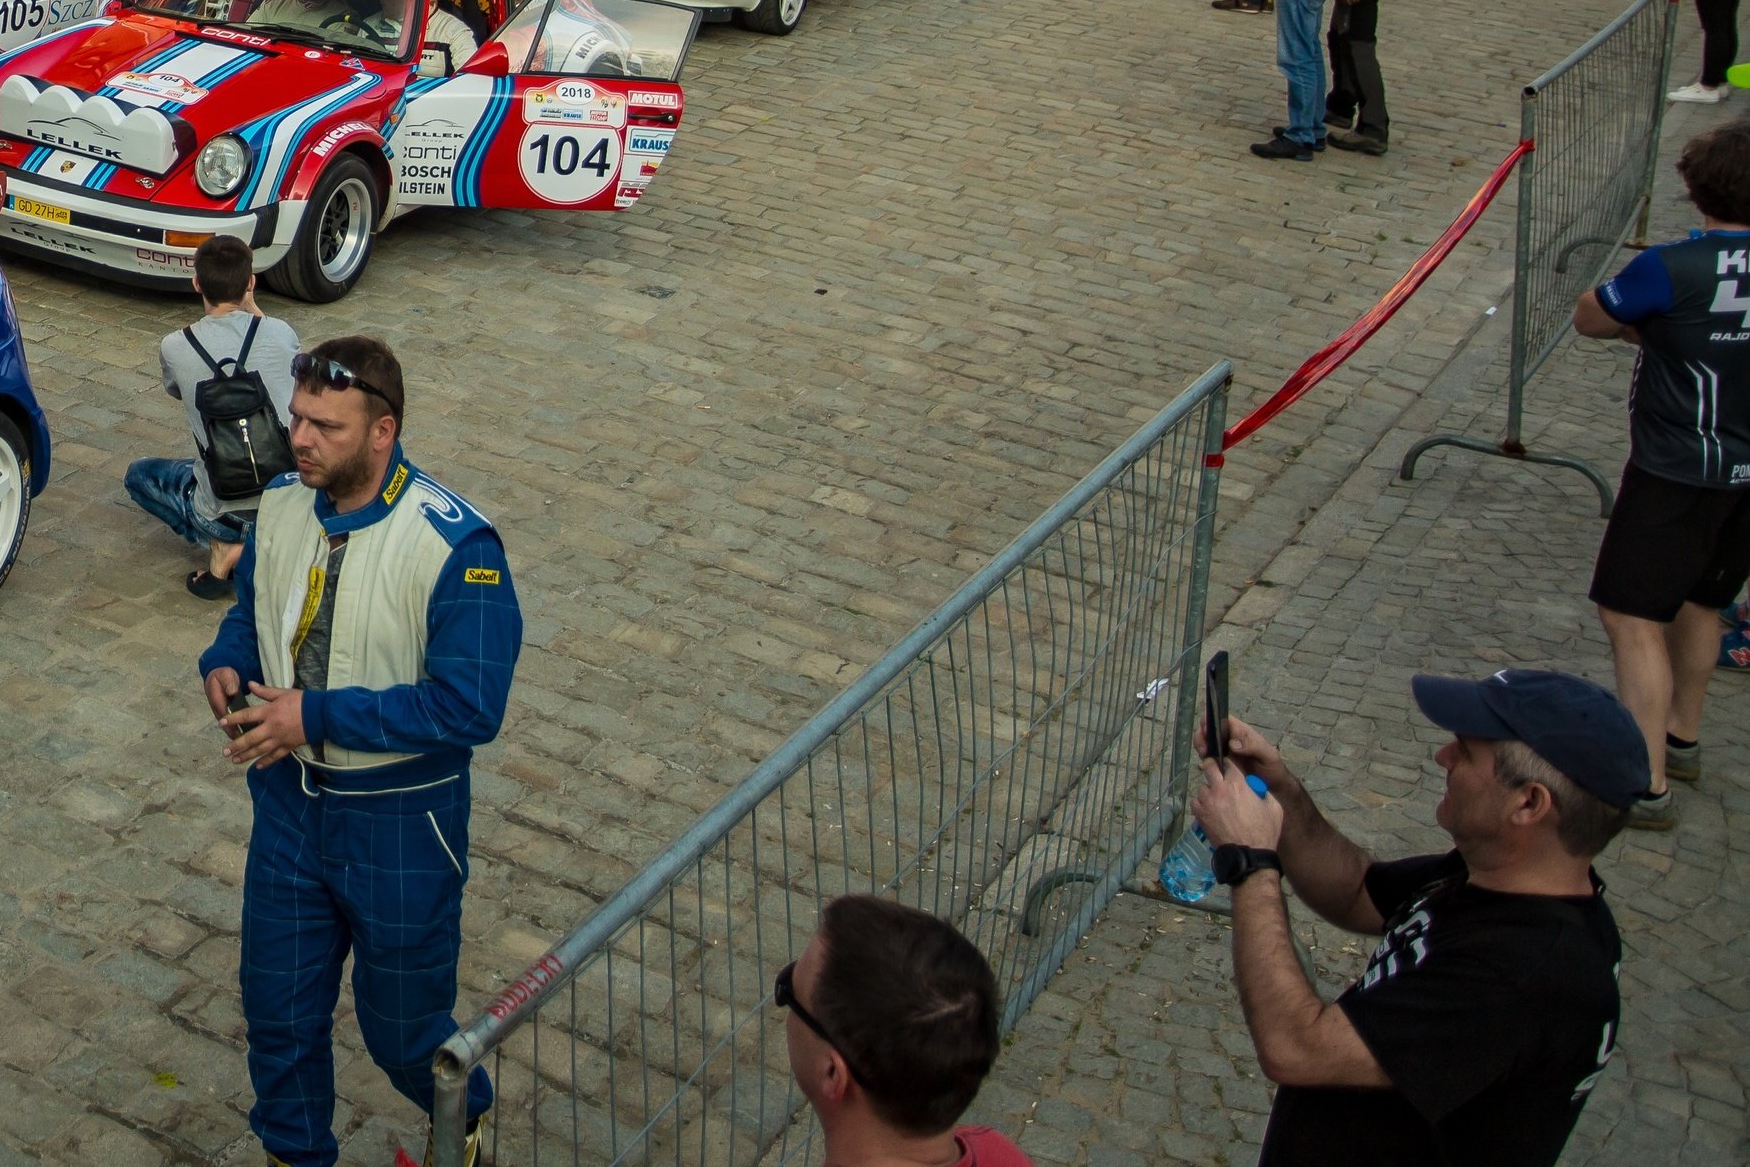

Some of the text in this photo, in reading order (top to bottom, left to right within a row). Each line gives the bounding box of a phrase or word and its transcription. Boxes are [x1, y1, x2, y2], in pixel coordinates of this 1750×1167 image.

[201, 26, 271, 46] conti
[159, 74, 180, 83] 104
[561, 87, 591, 98] 2018
[631, 93, 675, 106] MOTUL
[26, 128, 123, 161] LELLEK
[632, 138, 672, 151] KRAUS
[529, 134, 611, 178] 104
[17, 199, 32, 213] GD
[35, 202, 55, 220] 27H
[10, 227, 96, 255] LELLEK
[385, 465, 407, 502] Sabelt
[467, 569, 499, 583] Sabelt
